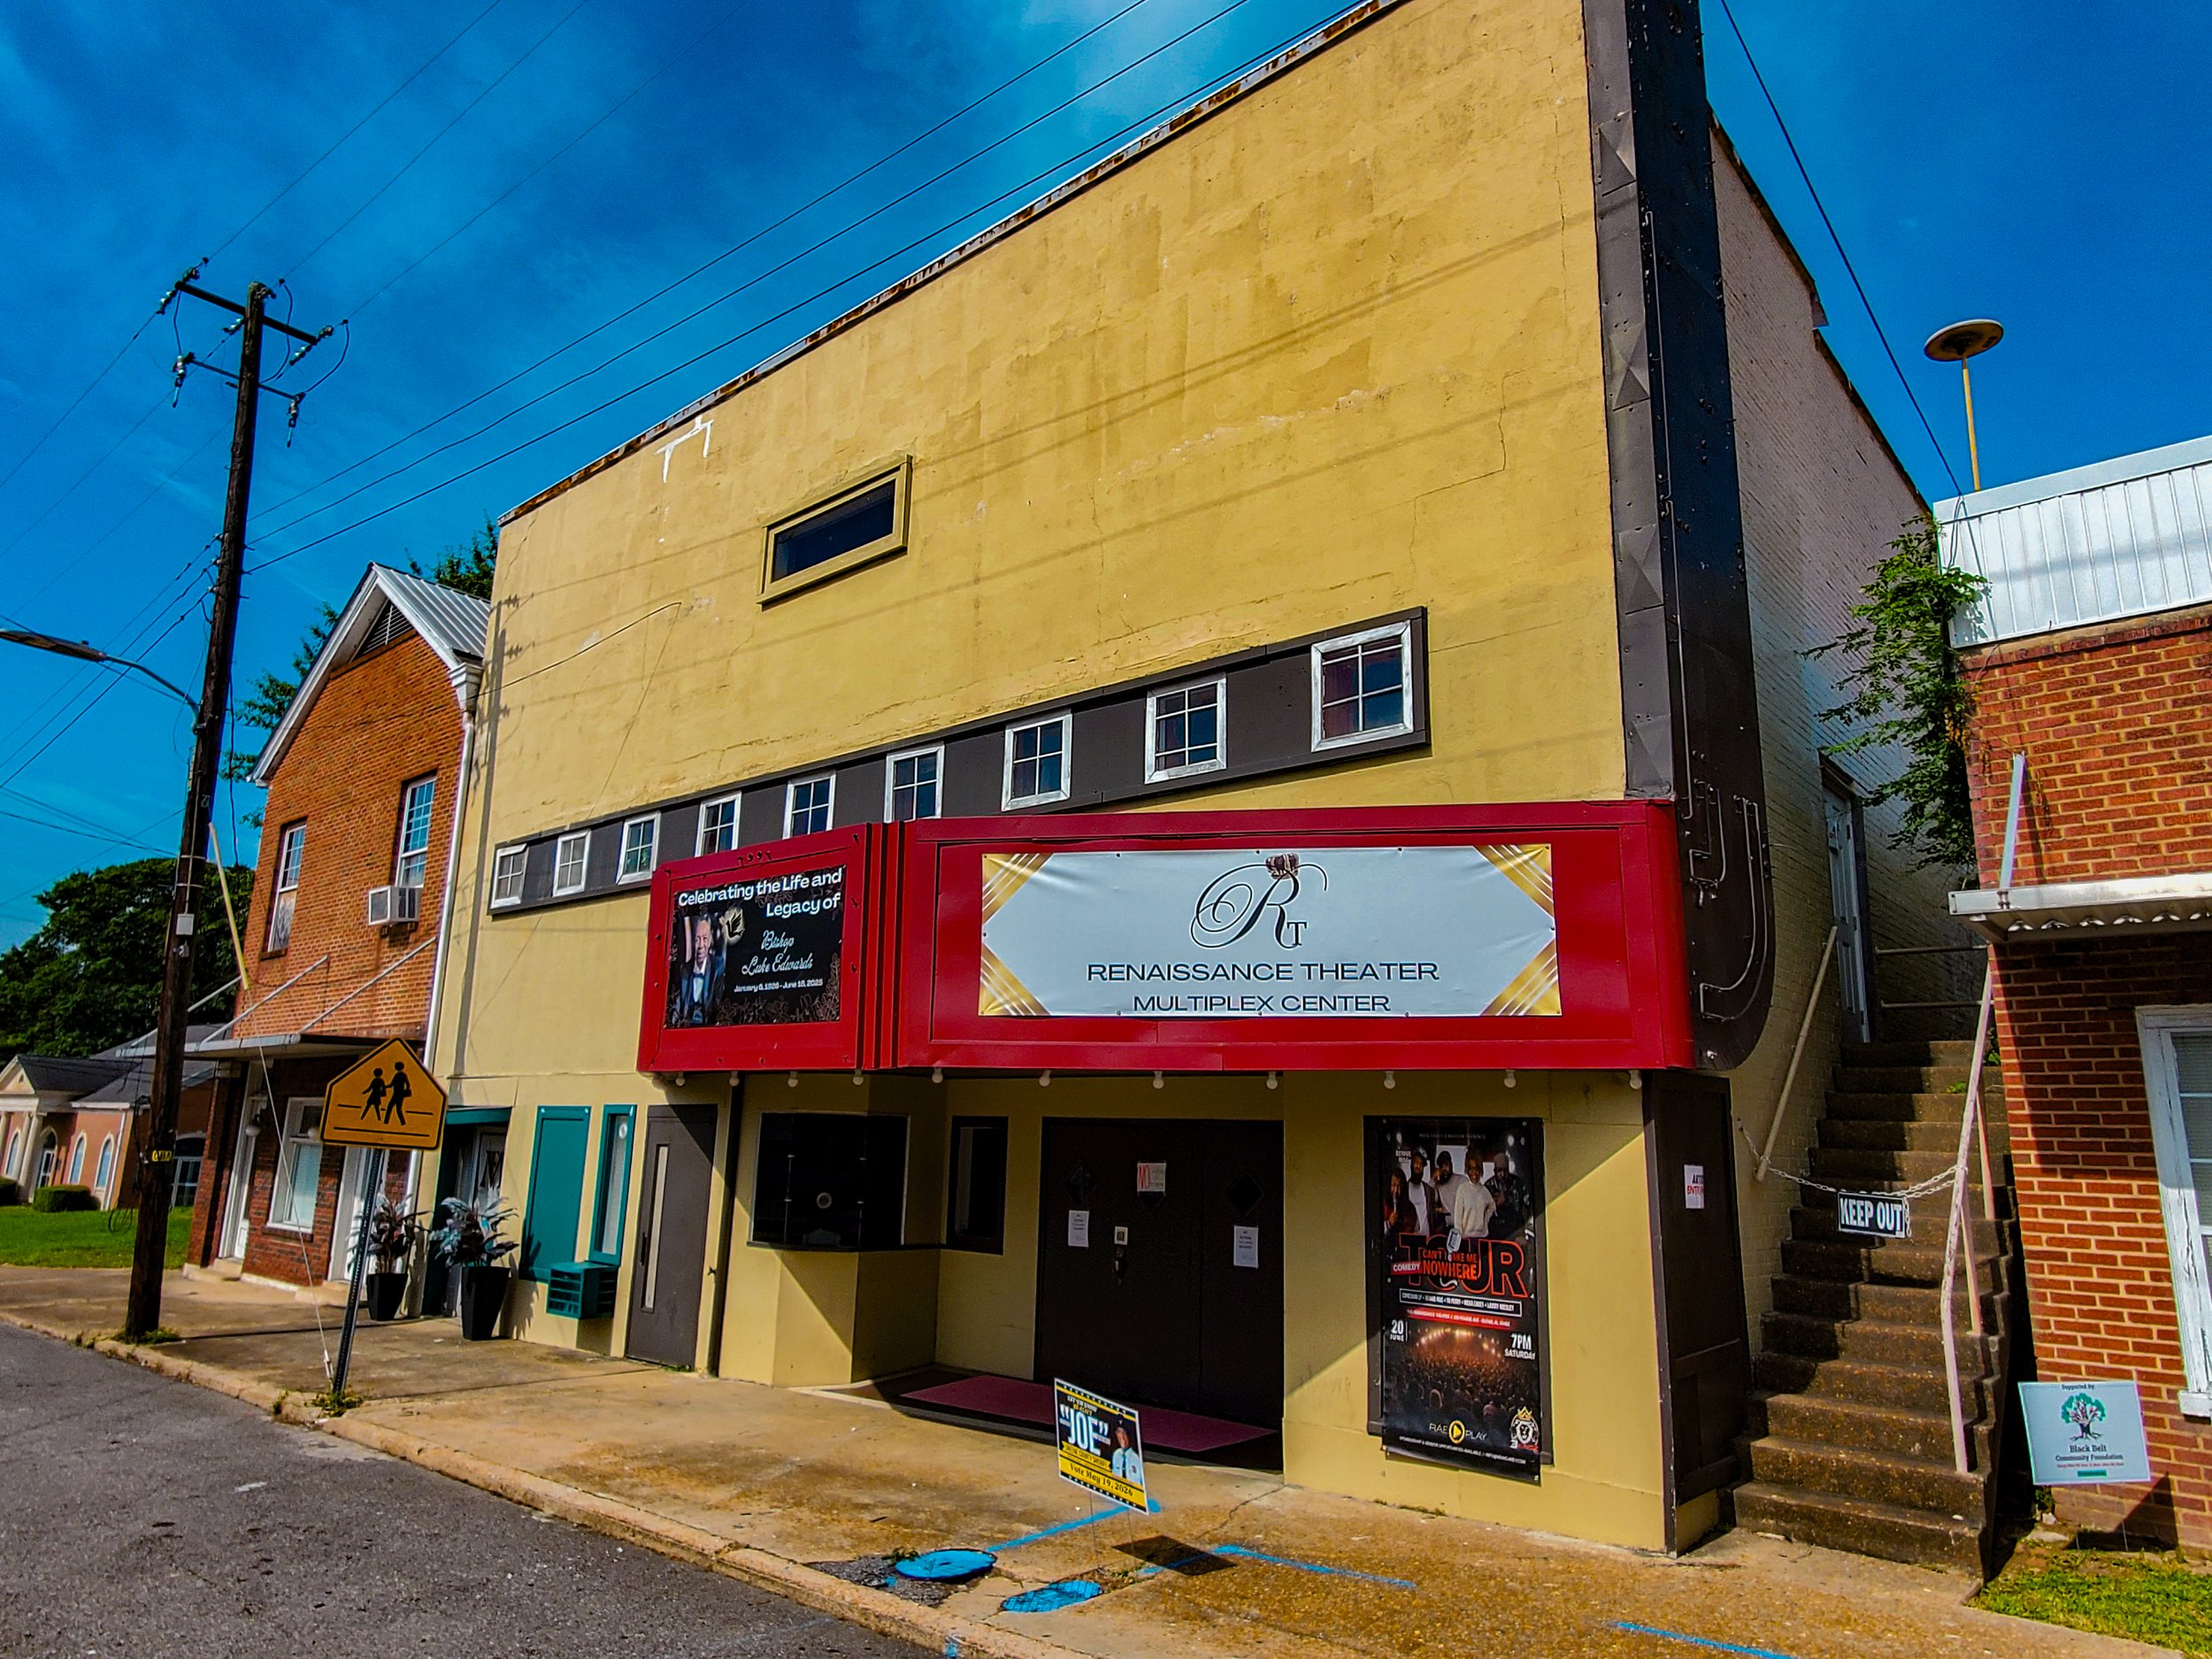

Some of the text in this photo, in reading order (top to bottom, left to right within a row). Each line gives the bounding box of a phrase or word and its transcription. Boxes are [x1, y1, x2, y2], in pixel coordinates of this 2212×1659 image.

[679, 870, 841, 907] Celebrating the Life and
[766, 894, 841, 918] Legacy of
[761, 930, 795, 954] Bishop
[741, 953, 813, 975] Luke Edwards
[1087, 962, 1440, 982] RENAISSANCE THEATER
[1132, 995, 1391, 1013] MULTIPLEX CENTER
[1839, 1197, 1902, 1232] KEEP OUT
[1393, 1263, 1420, 1271] COMEDY
[1466, 1253, 1477, 1263] ME
[1423, 1261, 1478, 1280] NOWHERE
[1391, 1319, 1404, 1334] 20
[1511, 1333, 1532, 1350] 7PM
[1504, 1348, 1536, 1360] SATURDAY
[1429, 1423, 1486, 1440] RAE PLAY
[2070, 1444, 2091, 1453] Black
[1070, 1463, 1085, 1476] Vote
[1086, 1470, 1101, 1484] May
[1115, 1482, 1133, 1496] 2026
